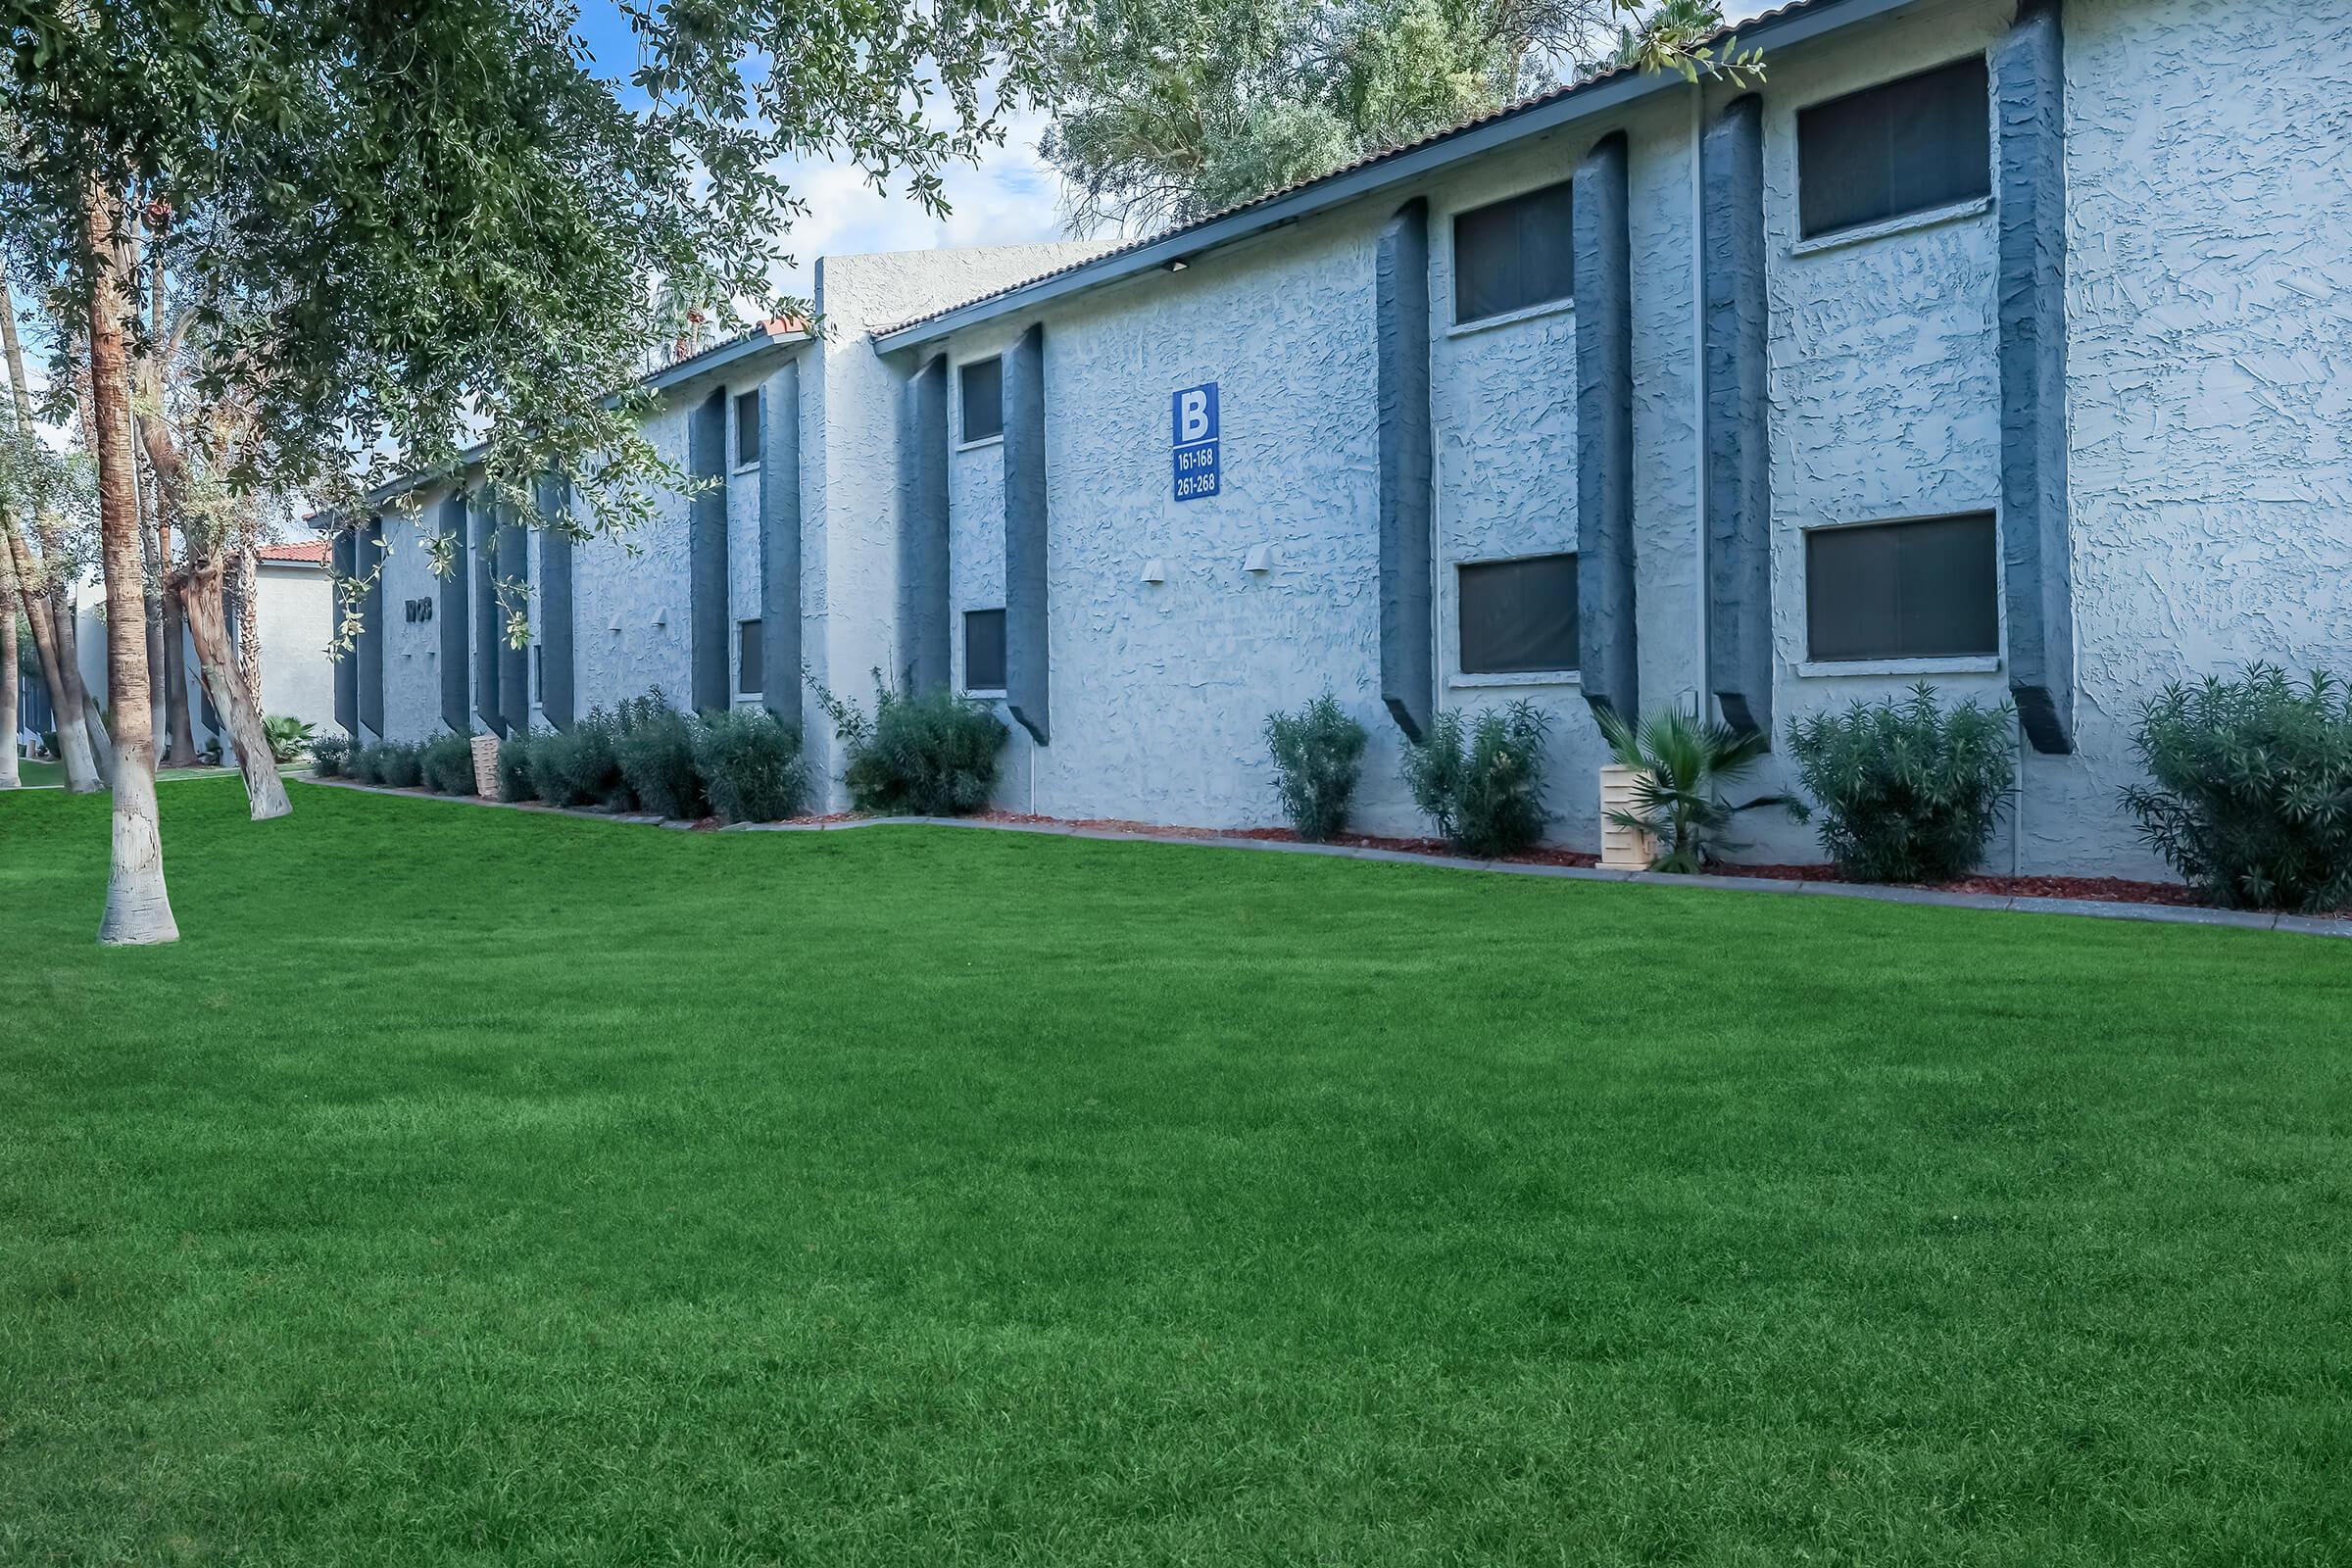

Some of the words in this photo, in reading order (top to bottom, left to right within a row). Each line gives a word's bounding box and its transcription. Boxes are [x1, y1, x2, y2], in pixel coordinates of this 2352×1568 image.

[1181, 390, 1208, 441] B
[1178, 448, 1213, 470] 161-168
[1177, 473, 1215, 496] 261-268
